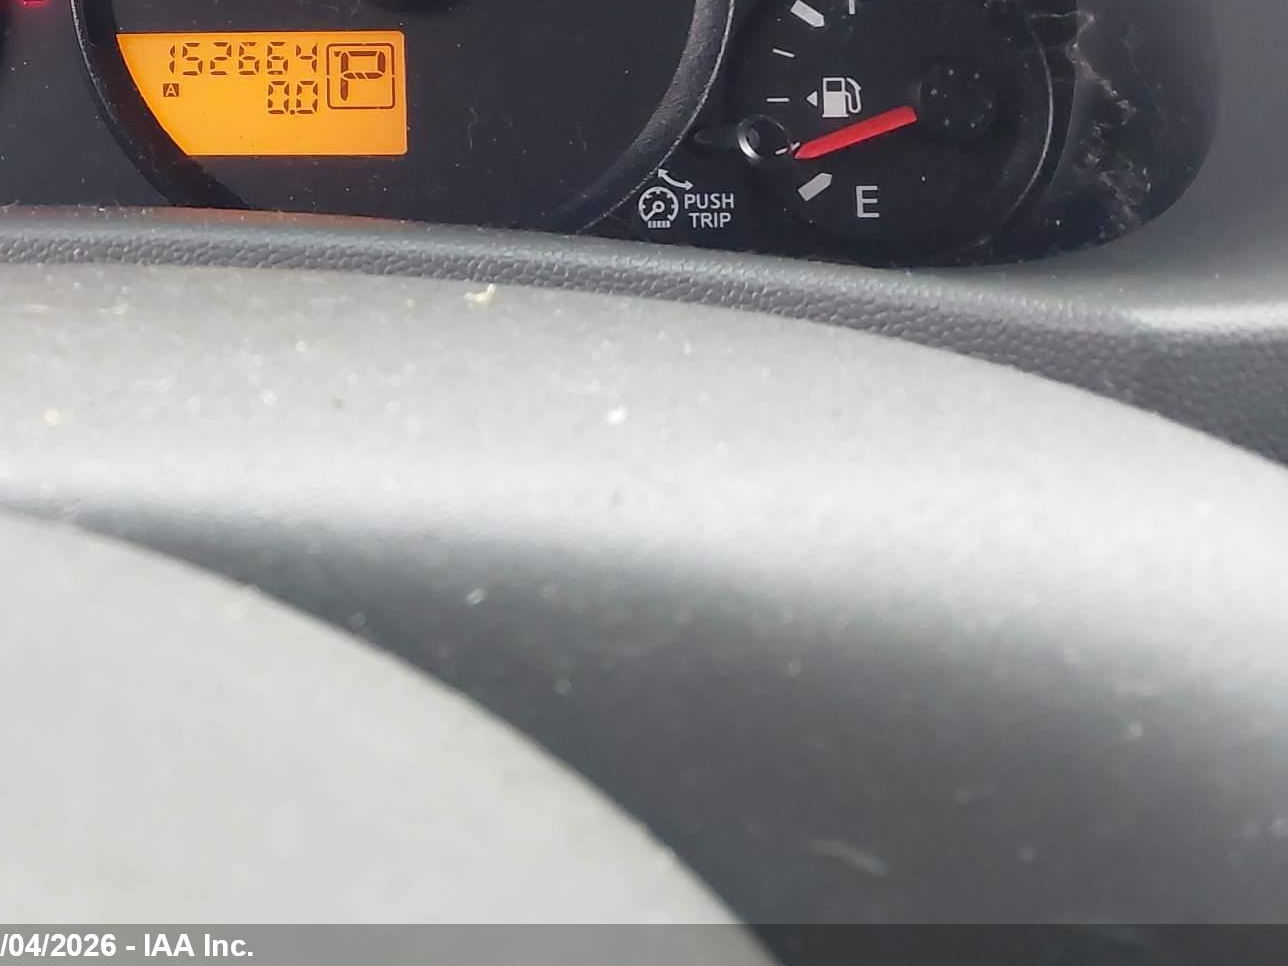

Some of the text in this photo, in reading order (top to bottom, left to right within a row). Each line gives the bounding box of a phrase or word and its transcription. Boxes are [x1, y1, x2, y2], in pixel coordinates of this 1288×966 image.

[170, 42, 317, 76] 152664
[163, 83, 179, 97] A
[334, 51, 386, 101] P
[268, 81, 318, 115] 0.0
[684, 193, 734, 210] PUSH
[856, 186, 879, 217] E
[688, 213, 731, 228] TRIP
